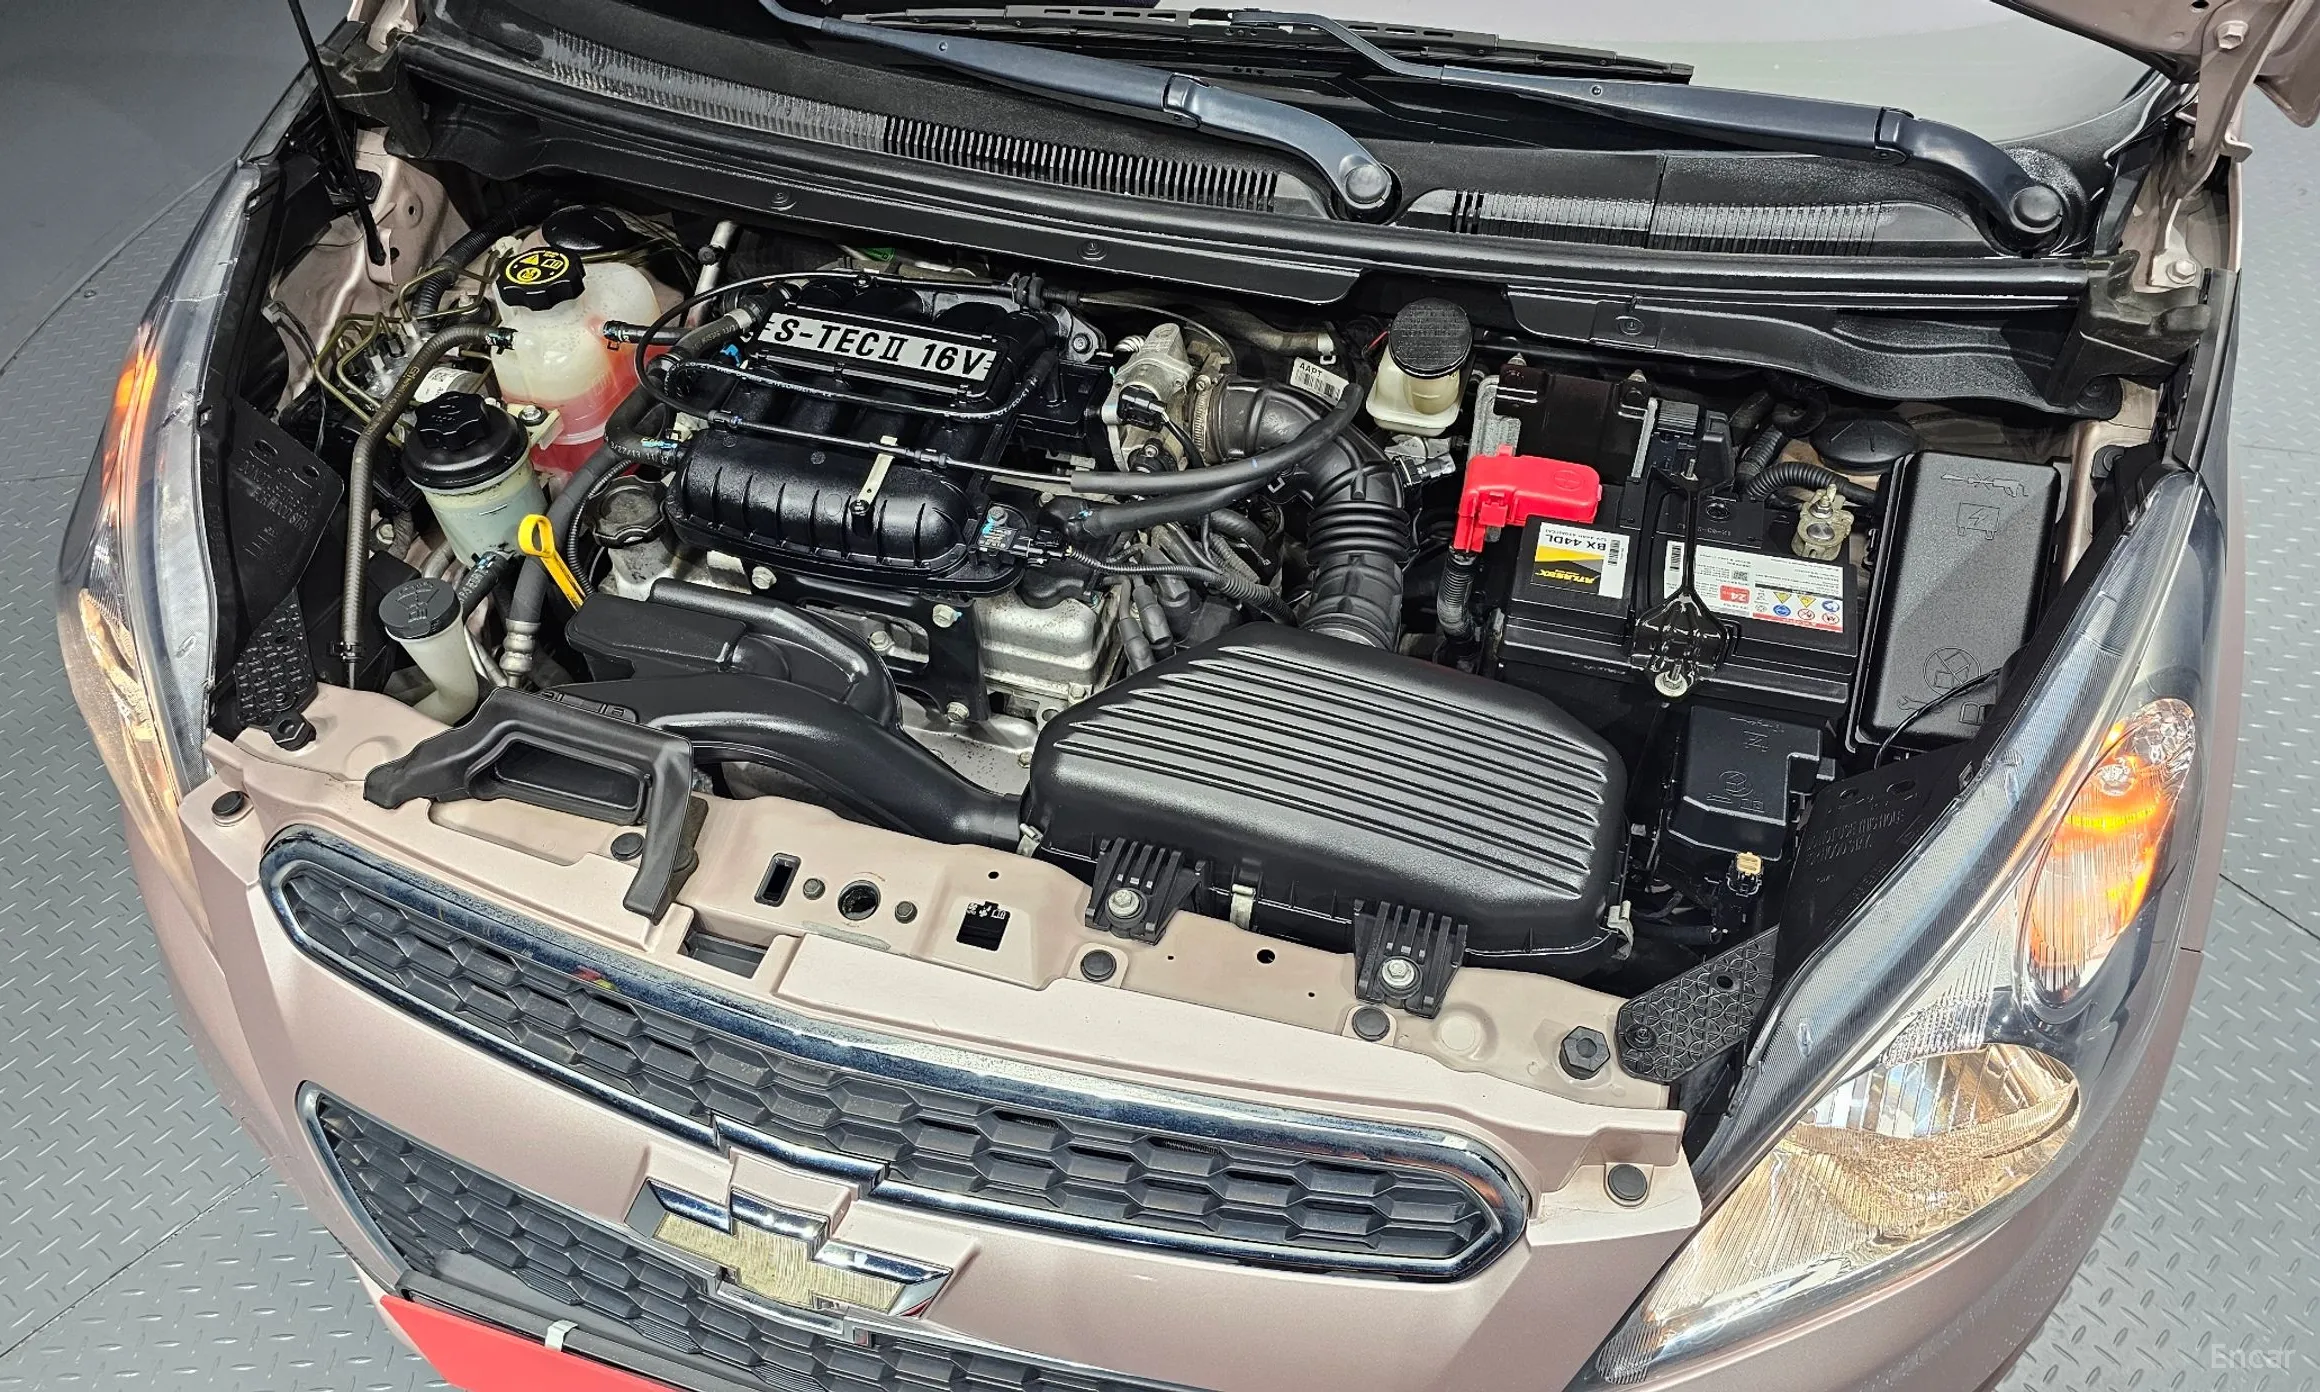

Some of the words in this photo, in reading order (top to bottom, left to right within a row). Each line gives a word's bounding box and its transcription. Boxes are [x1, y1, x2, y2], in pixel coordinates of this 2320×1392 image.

[920, 342, 986, 375] 16V
[1298, 361, 1323, 378] AAPT
[1545, 534, 1582, 547] 44DL
[1587, 541, 1607, 551] BX
[1730, 592, 1747, 602] 24
